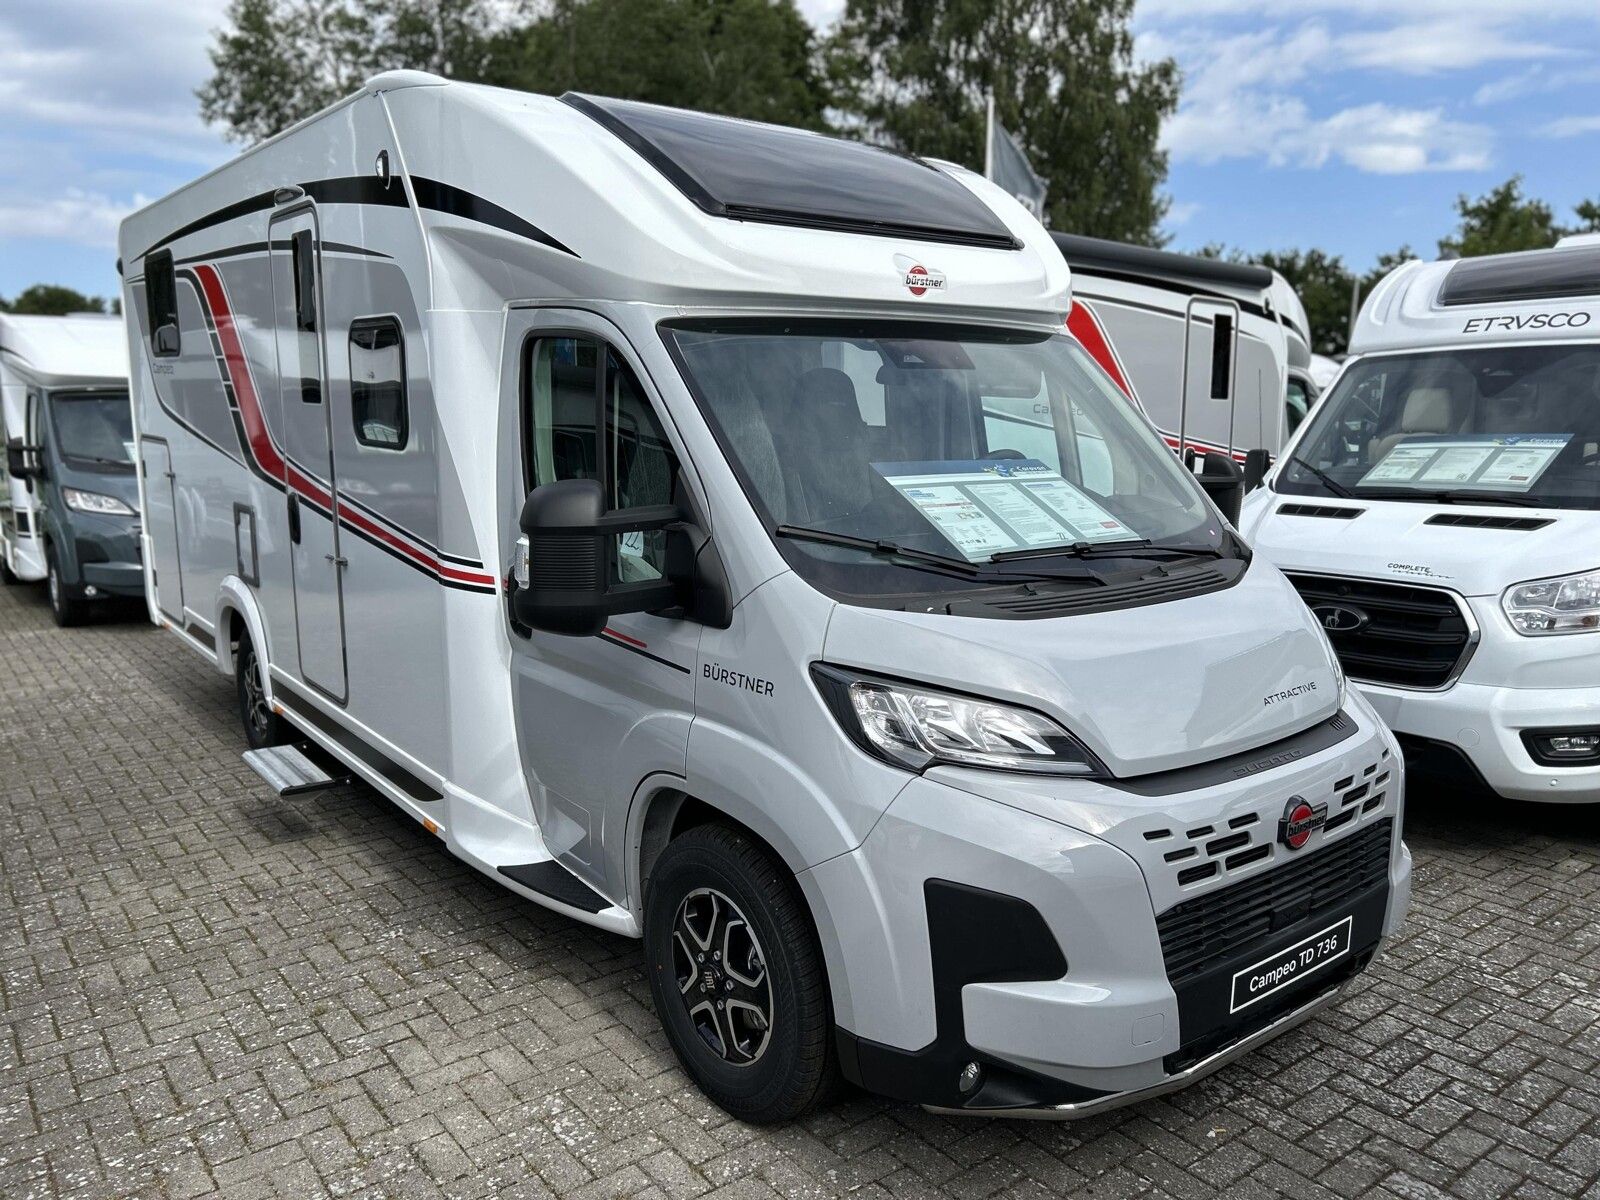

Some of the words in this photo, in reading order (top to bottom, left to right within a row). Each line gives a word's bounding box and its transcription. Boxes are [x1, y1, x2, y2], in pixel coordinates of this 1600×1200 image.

[905, 275, 943, 287] bürstner
[1387, 563, 1431, 573] COMPLETE
[703, 662, 774, 697] BÜRSTNER
[1263, 681, 1317, 706] ATTRACTIVE
[1249, 960, 1297, 992] Campeo
[1299, 947, 1314, 967] TD
[1317, 934, 1338, 958] 736
